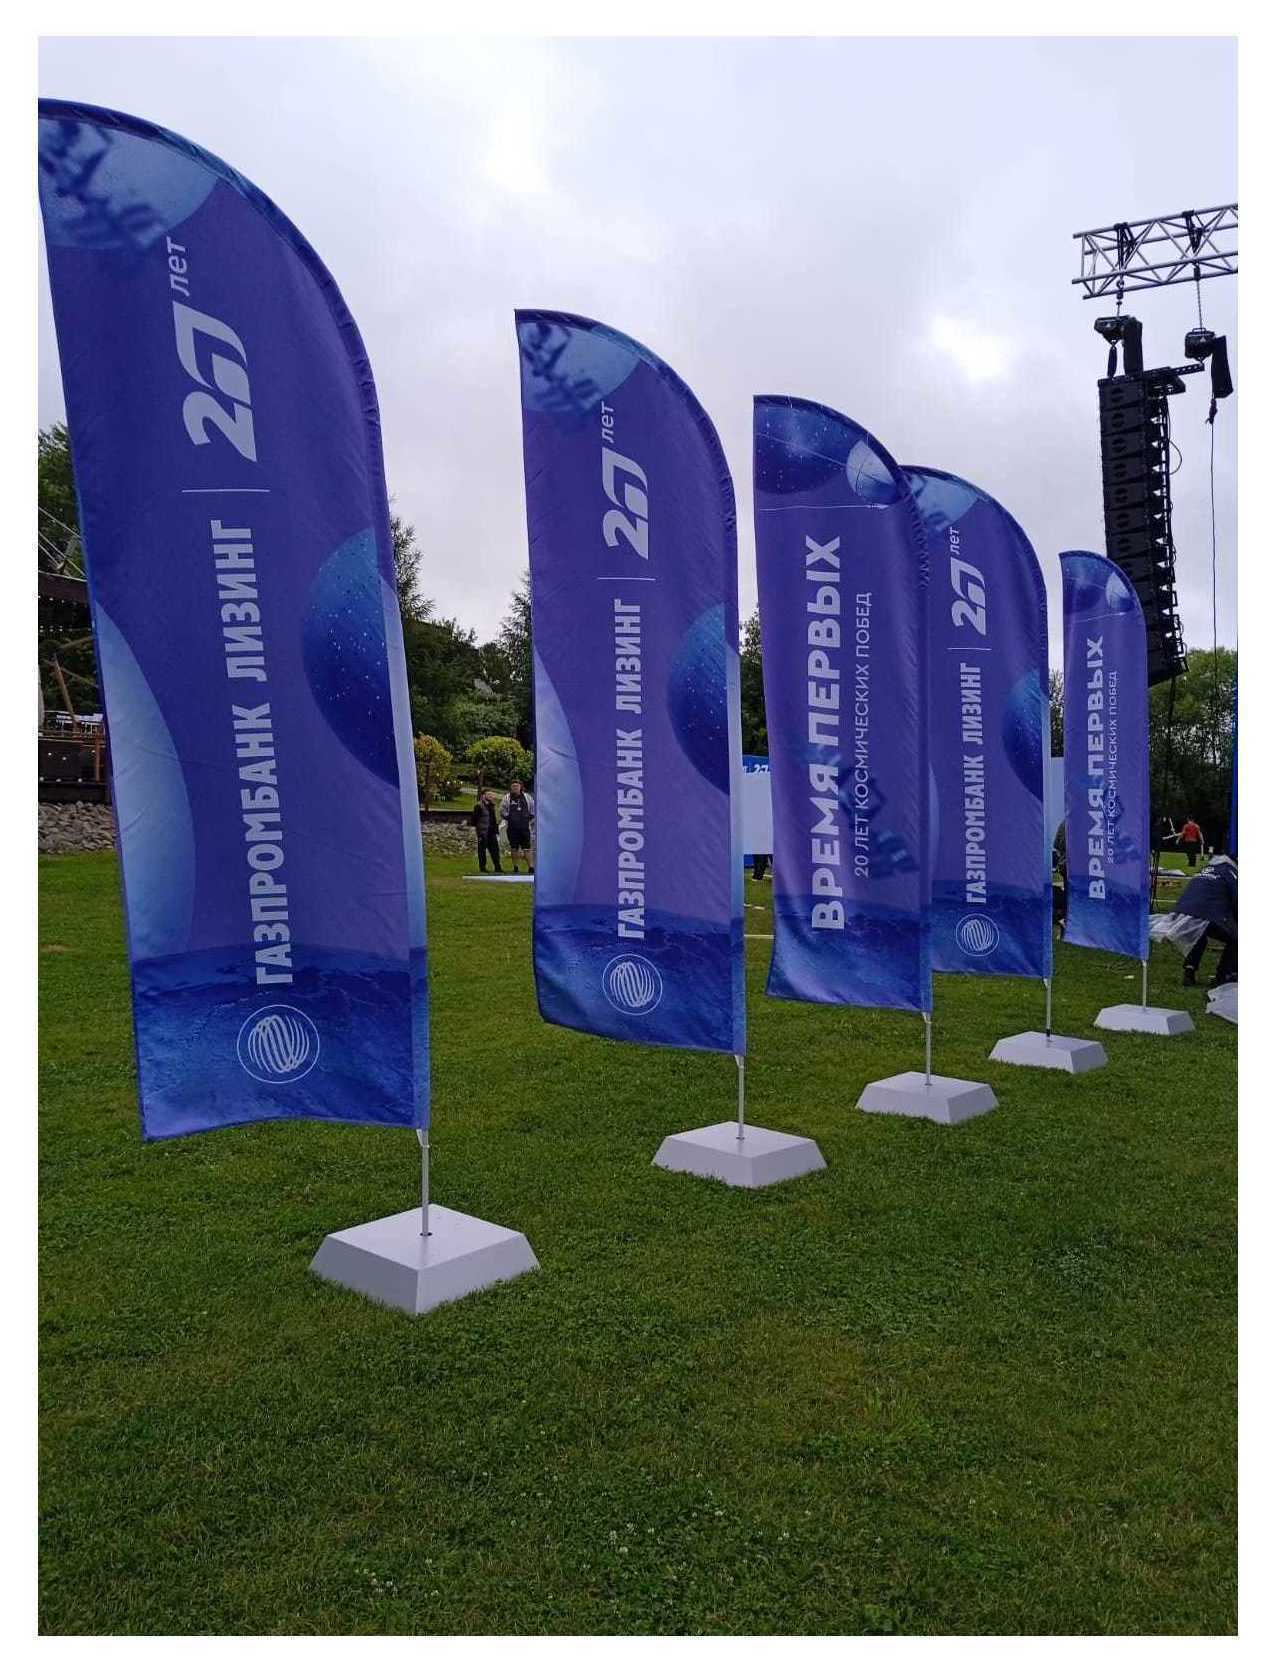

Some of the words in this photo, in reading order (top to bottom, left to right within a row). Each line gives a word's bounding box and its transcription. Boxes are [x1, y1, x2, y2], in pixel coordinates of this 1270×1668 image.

[166, 236, 191, 297] лет
[172, 300, 258, 463] 20
[601, 401, 615, 444] лет
[601, 447, 649, 561] 20
[949, 527, 961, 555] лет
[211, 518, 268, 683] ЛИЗИНГ
[613, 598, 643, 715] ЛИЗИНГ
[805, 534, 841, 747] ПЕРВЫХ
[855, 592, 873, 657] ПОБЕД
[854, 663, 871, 810] КОСМИЧЕСКИХ
[959, 662, 984, 746] ЛИЗИНГ
[1086, 634, 1104, 776] ПЕРВЫХ
[1108, 670, 1119, 715] ПОБЕД
[1107, 719, 1118, 818] КОСМИЧЕСКИХ
[231, 702, 295, 986] ГАЗПРОМБАНК
[615, 728, 645, 941] ГАЗПРОМБАНК
[808, 763, 845, 930] ВРЕМЯ
[854, 816, 870, 851] ЛЕТ
[854, 854, 869, 878] 20
[963, 754, 987, 904] ГАЗПРОМБАНК
[1087, 788, 1106, 900] ВРЕМЯ
[1107, 820, 1116, 845] ЛЕТ
